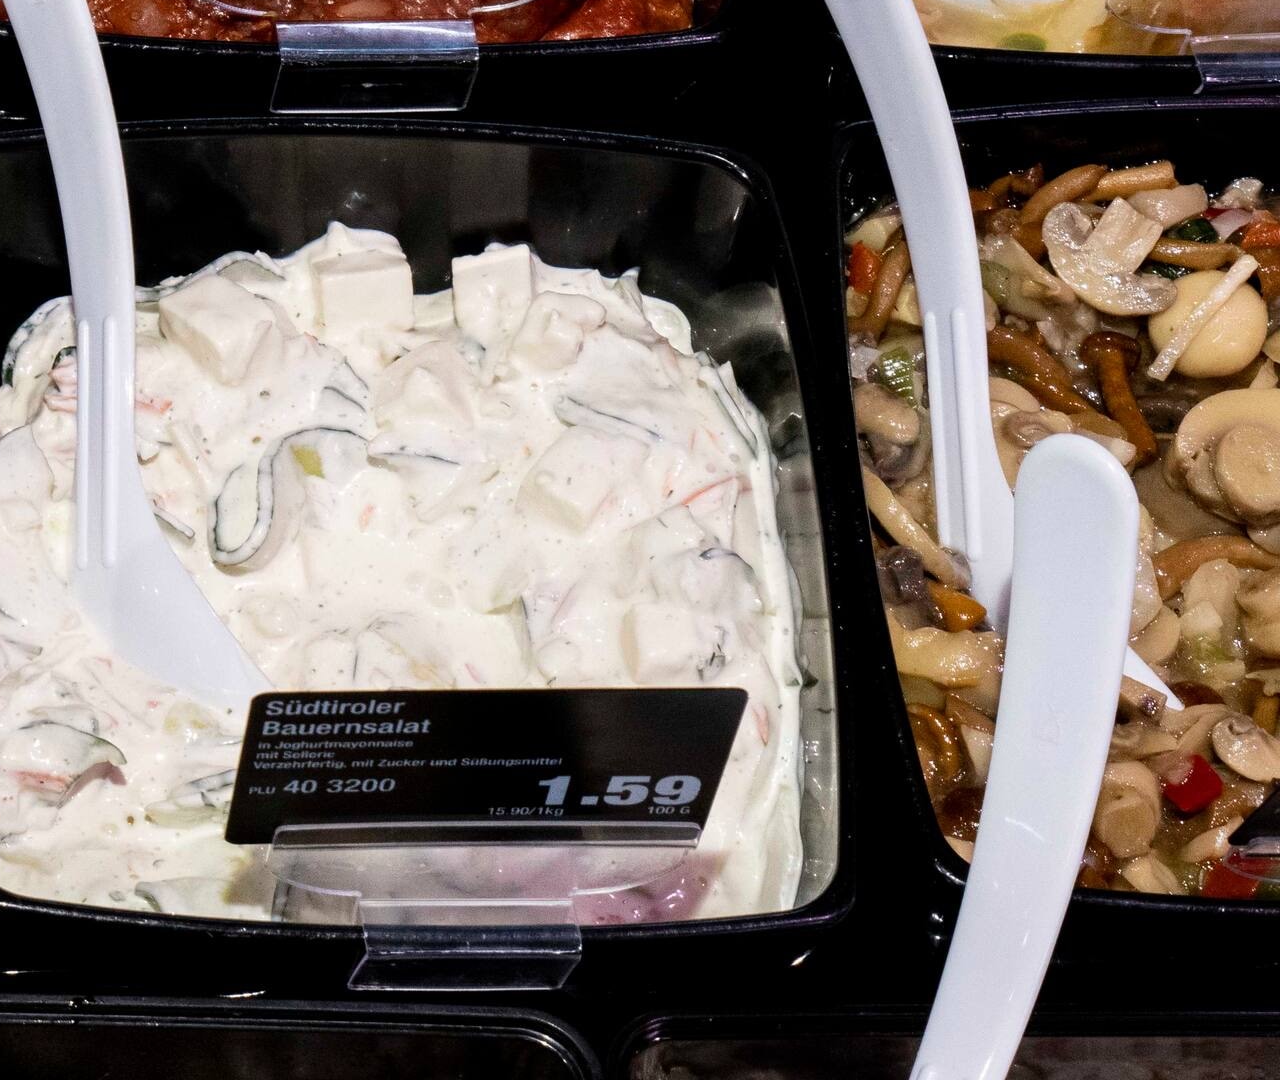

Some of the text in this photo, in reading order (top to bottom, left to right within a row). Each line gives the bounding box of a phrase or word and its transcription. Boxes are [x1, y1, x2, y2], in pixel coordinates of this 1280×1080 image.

[265, 699, 406, 716] Südtiroler
[261, 718, 431, 736] Bauernsalat
[257, 740, 414, 753] in Joghurtmayonnaise
[255, 751, 280, 760] mit
[351, 759, 375, 768] mit
[377, 758, 426, 768] Zucker
[429, 758, 458, 767] und
[248, 777, 396, 795] PLU 40 3200
[538, 774, 702, 806] 1.59
[488, 806, 564, 817] 15.90/1kg
[647, 805, 691, 815] 100 G
